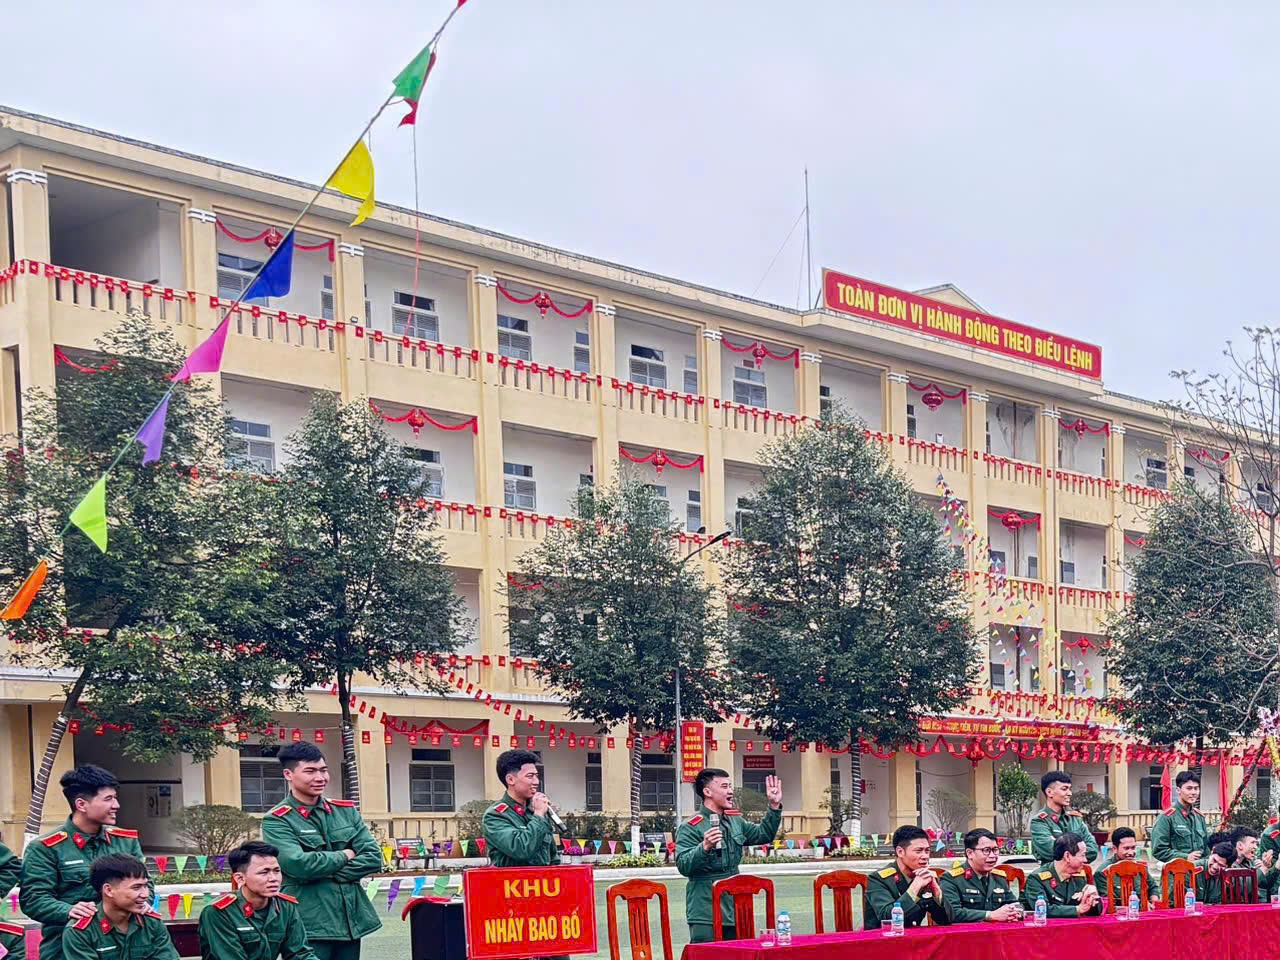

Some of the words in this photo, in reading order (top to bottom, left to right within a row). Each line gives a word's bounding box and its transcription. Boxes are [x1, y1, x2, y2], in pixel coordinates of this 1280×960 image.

[837, 283, 875, 311] TOÀN
[878, 295, 907, 320] ĐƠN
[910, 302, 924, 329] VỊ
[926, 304, 962, 336] HÀNH
[965, 316, 1000, 345] ĐỘNG
[1002, 328, 1032, 354] THEO
[1064, 345, 1092, 371] LỆNH
[504, 878, 560, 898] KHU
[485, 909, 524, 944] NHẢY
[528, 915, 558, 942] BAO
[561, 905, 581, 940] BỐ
